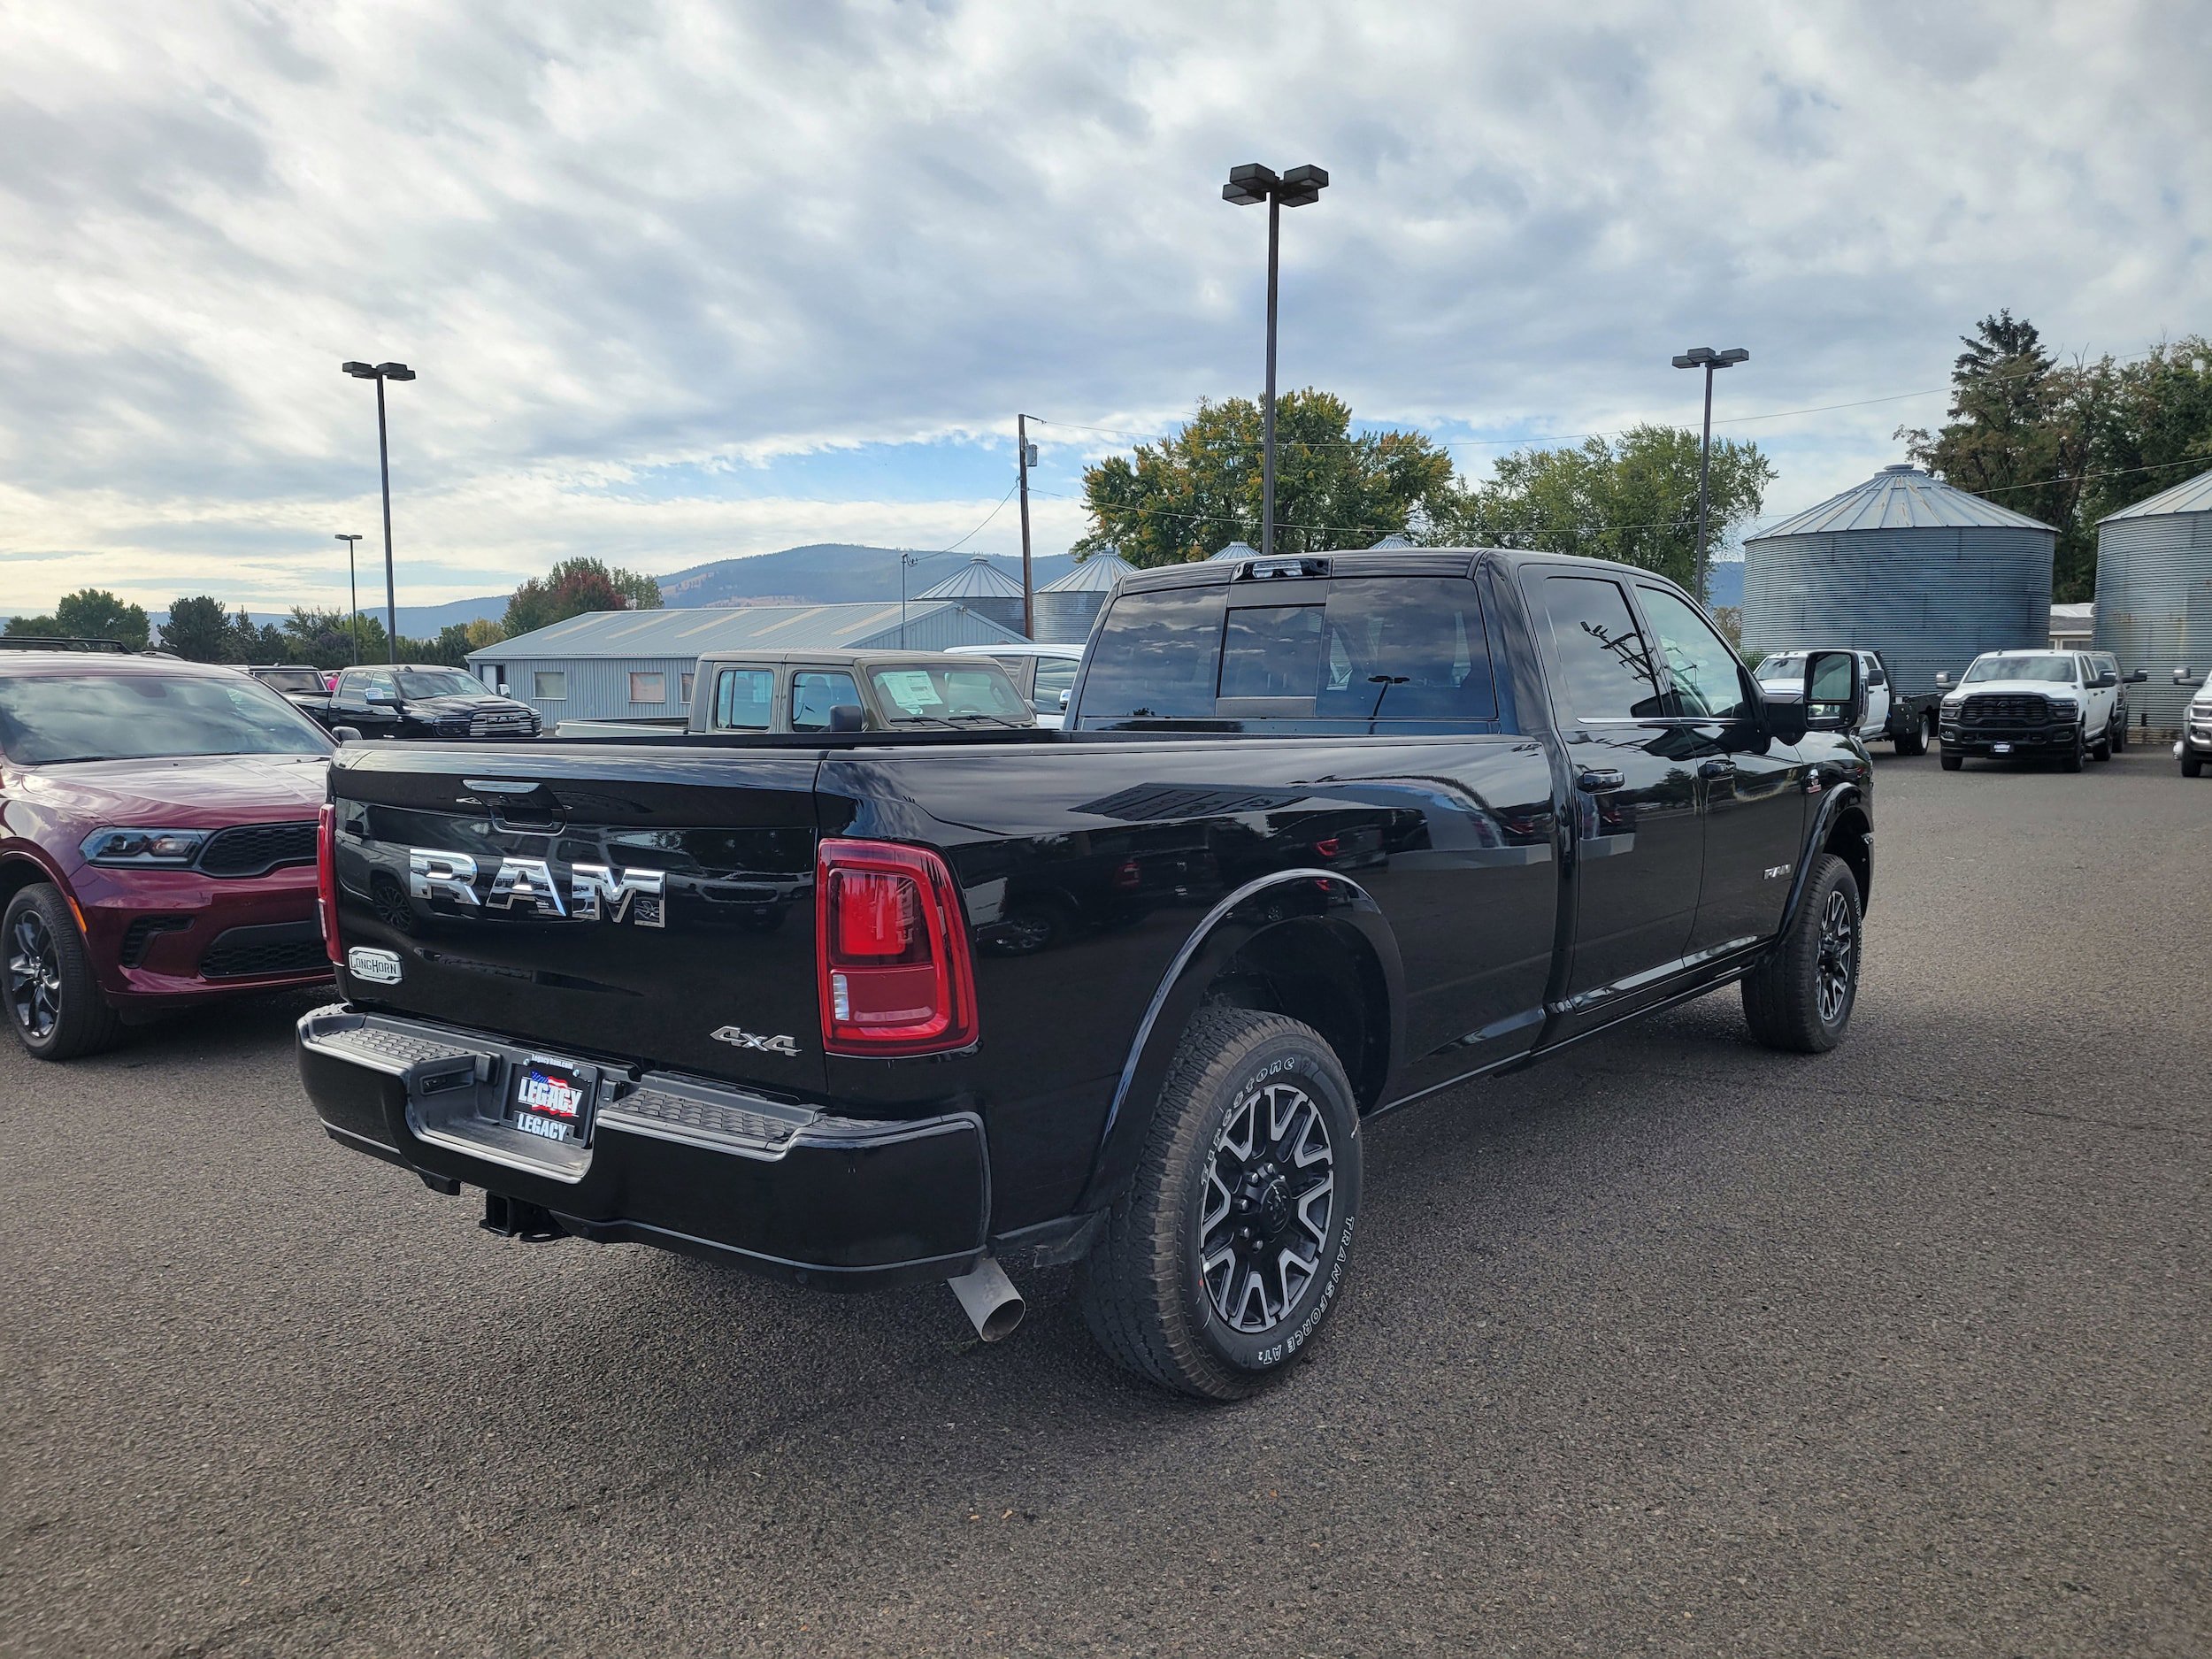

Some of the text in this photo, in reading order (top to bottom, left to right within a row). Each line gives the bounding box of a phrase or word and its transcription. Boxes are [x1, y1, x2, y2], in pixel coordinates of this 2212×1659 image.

[410, 849, 665, 927] RAM
[350, 956, 397, 974] LONGHORN
[518, 1078, 582, 1115] LEGACY
[518, 1114, 567, 1141] LEGACY
[1287, 1216, 1355, 1353] TRANSFORCE
